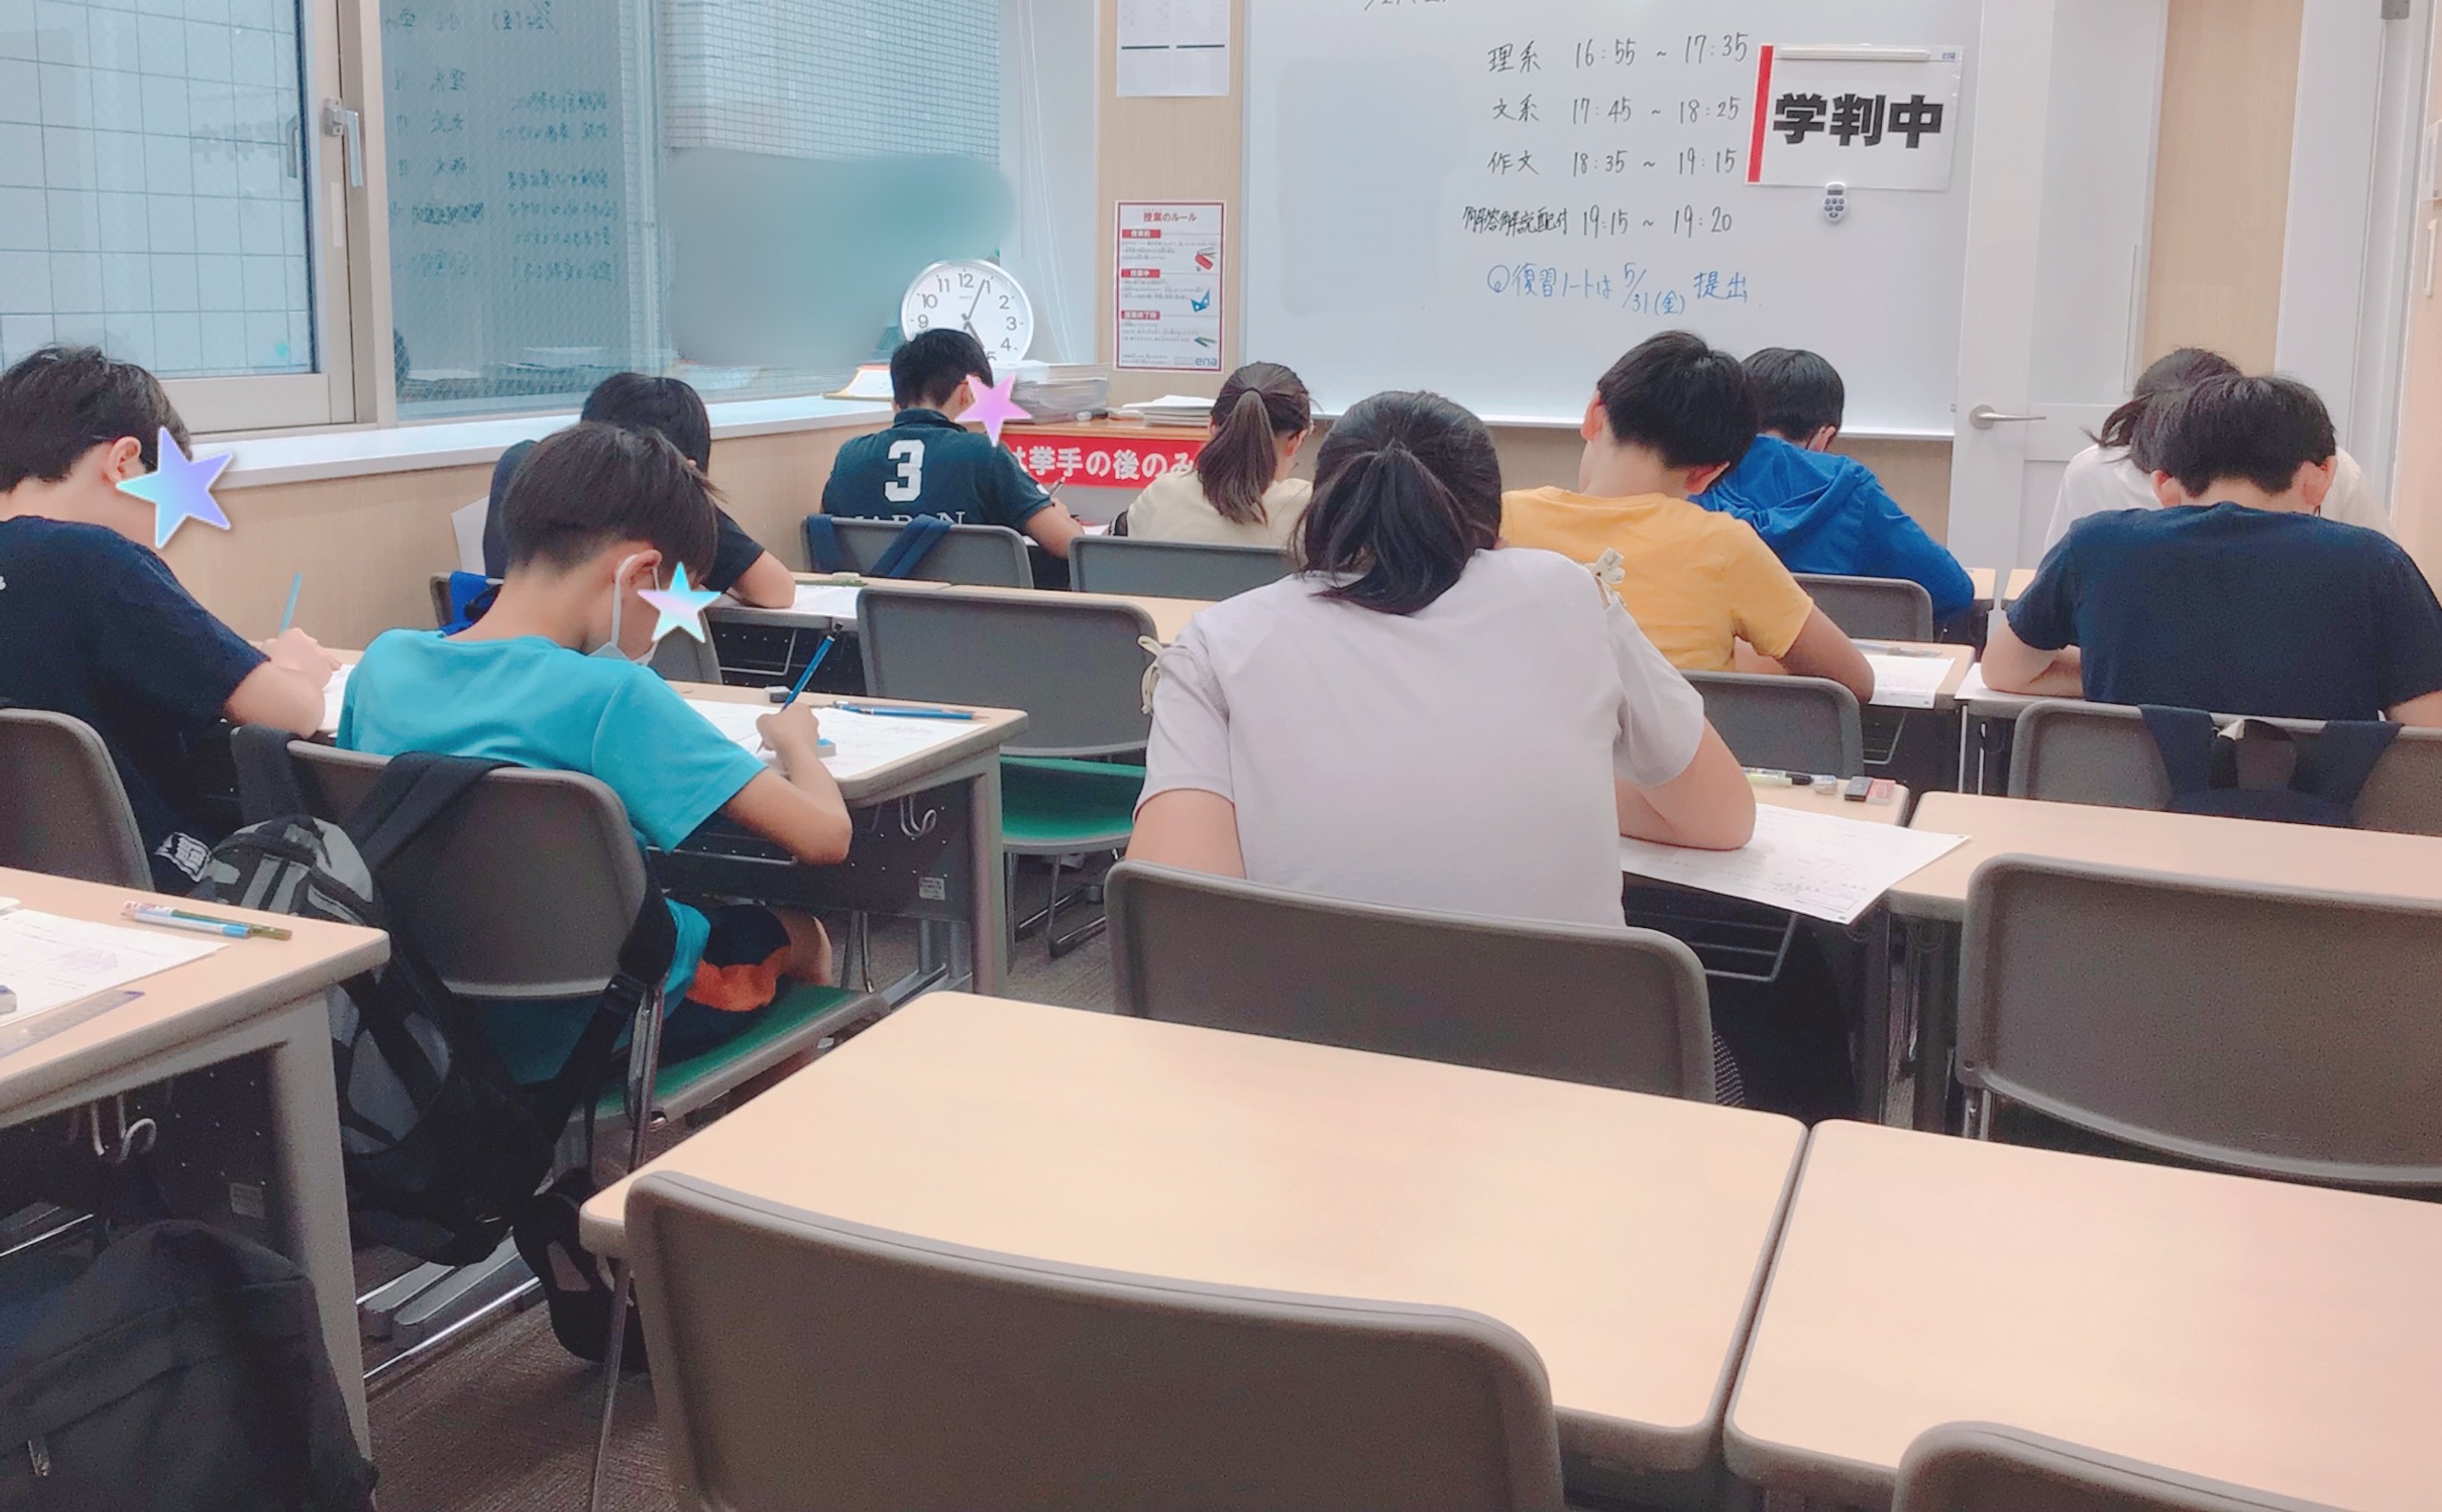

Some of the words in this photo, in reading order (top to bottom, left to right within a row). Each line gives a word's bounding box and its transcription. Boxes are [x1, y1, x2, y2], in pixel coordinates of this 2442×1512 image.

[1488, 40, 1542, 72] 理系
[1576, 38, 1636, 69] 16:55
[1685, 31, 1749, 64] 17:35
[1492, 93, 1541, 123] 文系
[1573, 96, 1632, 125] 17:45
[1679, 95, 1741, 125] 18:25
[1772, 93, 1944, 149] 学判中
[1487, 150, 1541, 176] 作文
[1573, 149, 1629, 177] 18:35
[1679, 146, 1737, 176] 19:15
[1462, 205, 1567, 238] 解答解説配付
[1583, 204, 1629, 238] 19:15
[1672, 205, 1733, 238] 19:20
[938, 278, 950, 293] 11
[958, 273, 974, 288] 12
[1693, 270, 1748, 304] 提出
[921, 294, 938, 308] 10
[999, 295, 1009, 309] 2
[918, 314, 929, 329] 9
[1006, 316, 1017, 331] 3
[1001, 337, 1011, 351] 4
[1195, 357, 1217, 366] ena
[884, 439, 926, 503] 3
